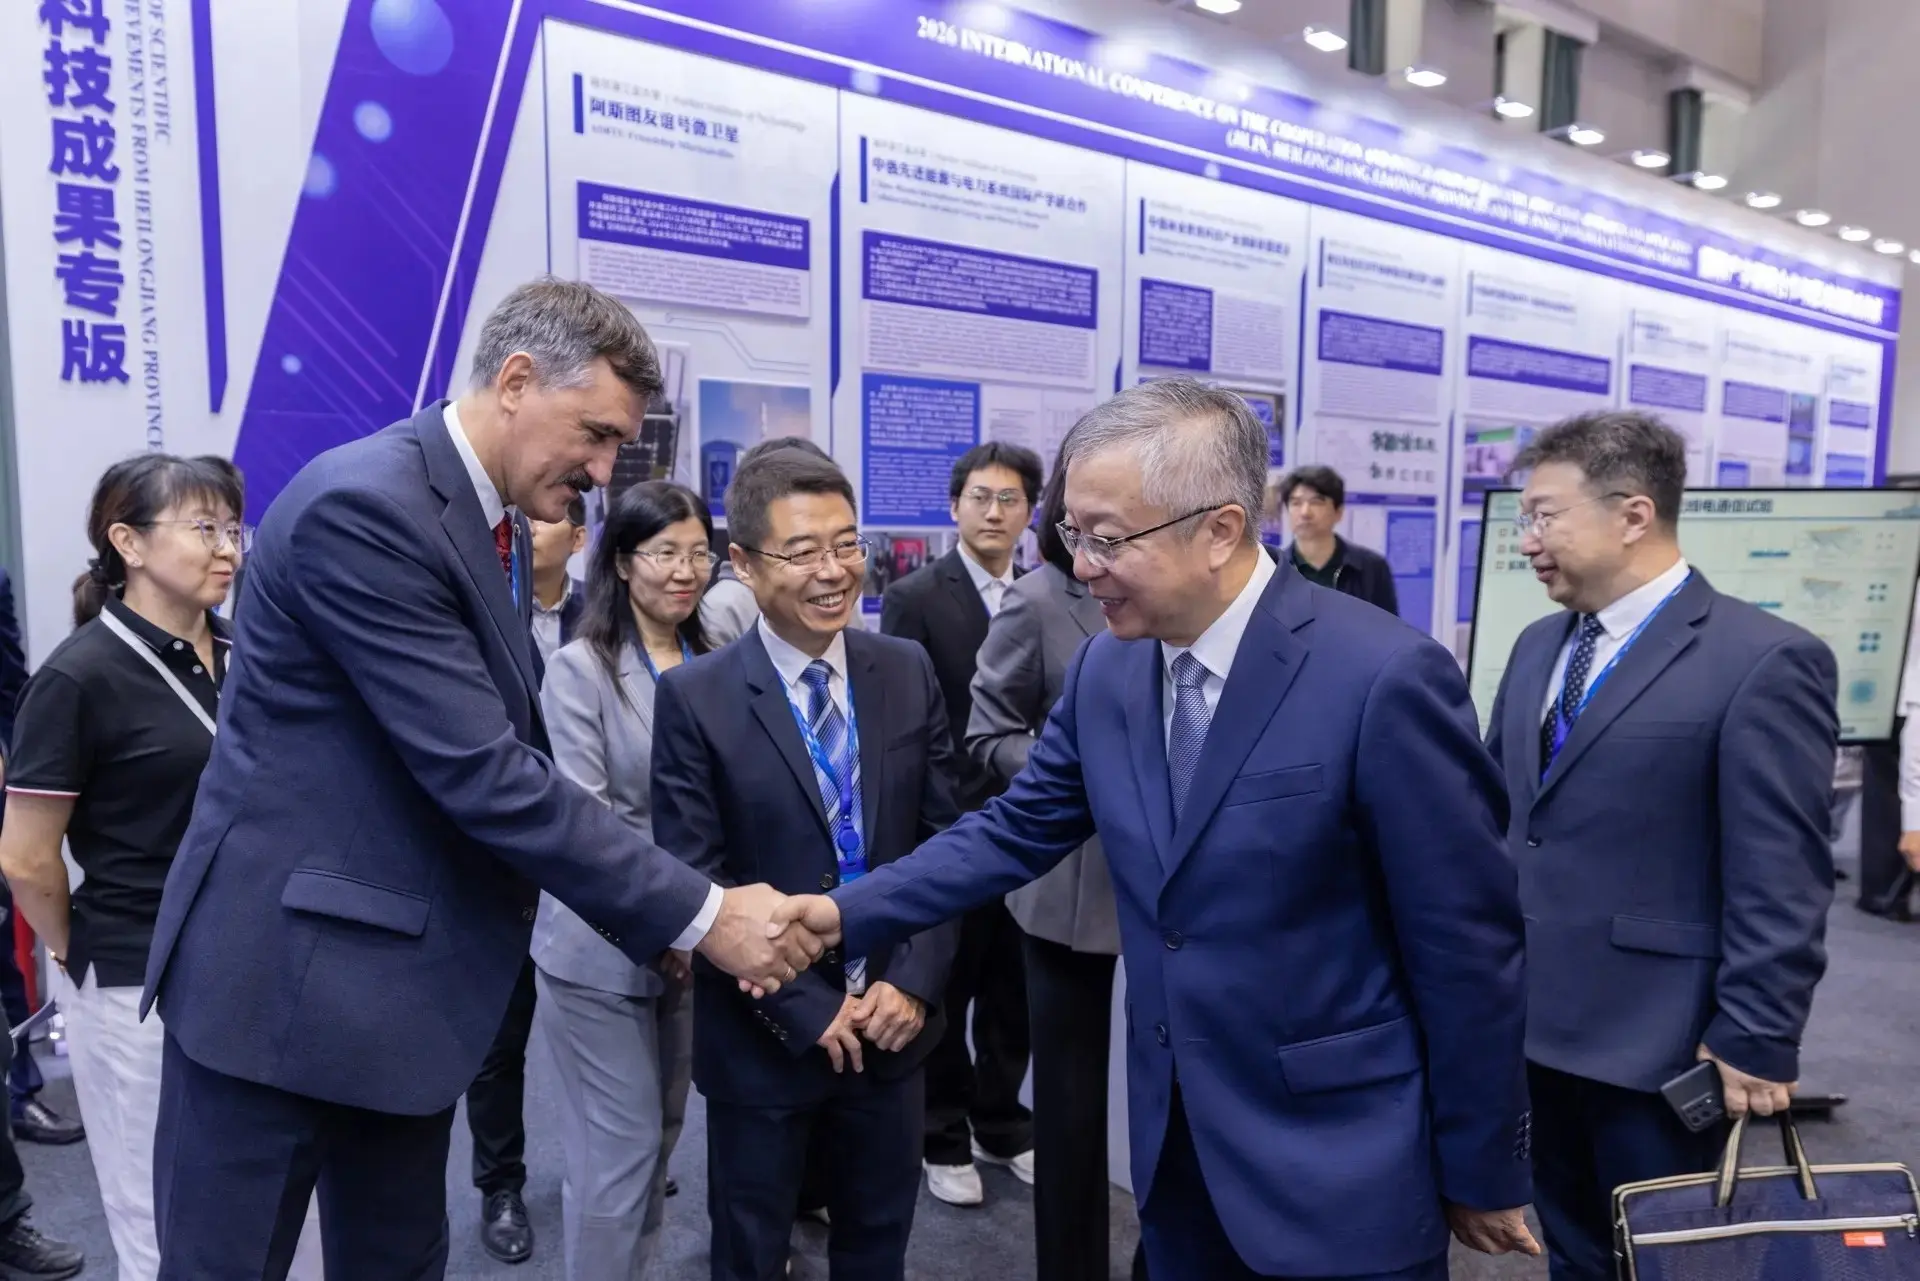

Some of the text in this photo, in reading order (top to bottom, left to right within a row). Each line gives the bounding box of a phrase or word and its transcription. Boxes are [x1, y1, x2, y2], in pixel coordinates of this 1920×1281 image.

[151, 27, 171, 145] SCIENTIFIC
[916, 14, 957, 47] 2026
[961, 28, 1107, 87] INTERNATIONAL
[131, 124, 151, 183] FROM
[590, 96, 740, 143] 阿斯图友谊号微卫星
[134, 189, 157, 343] HEILONGJIANG
